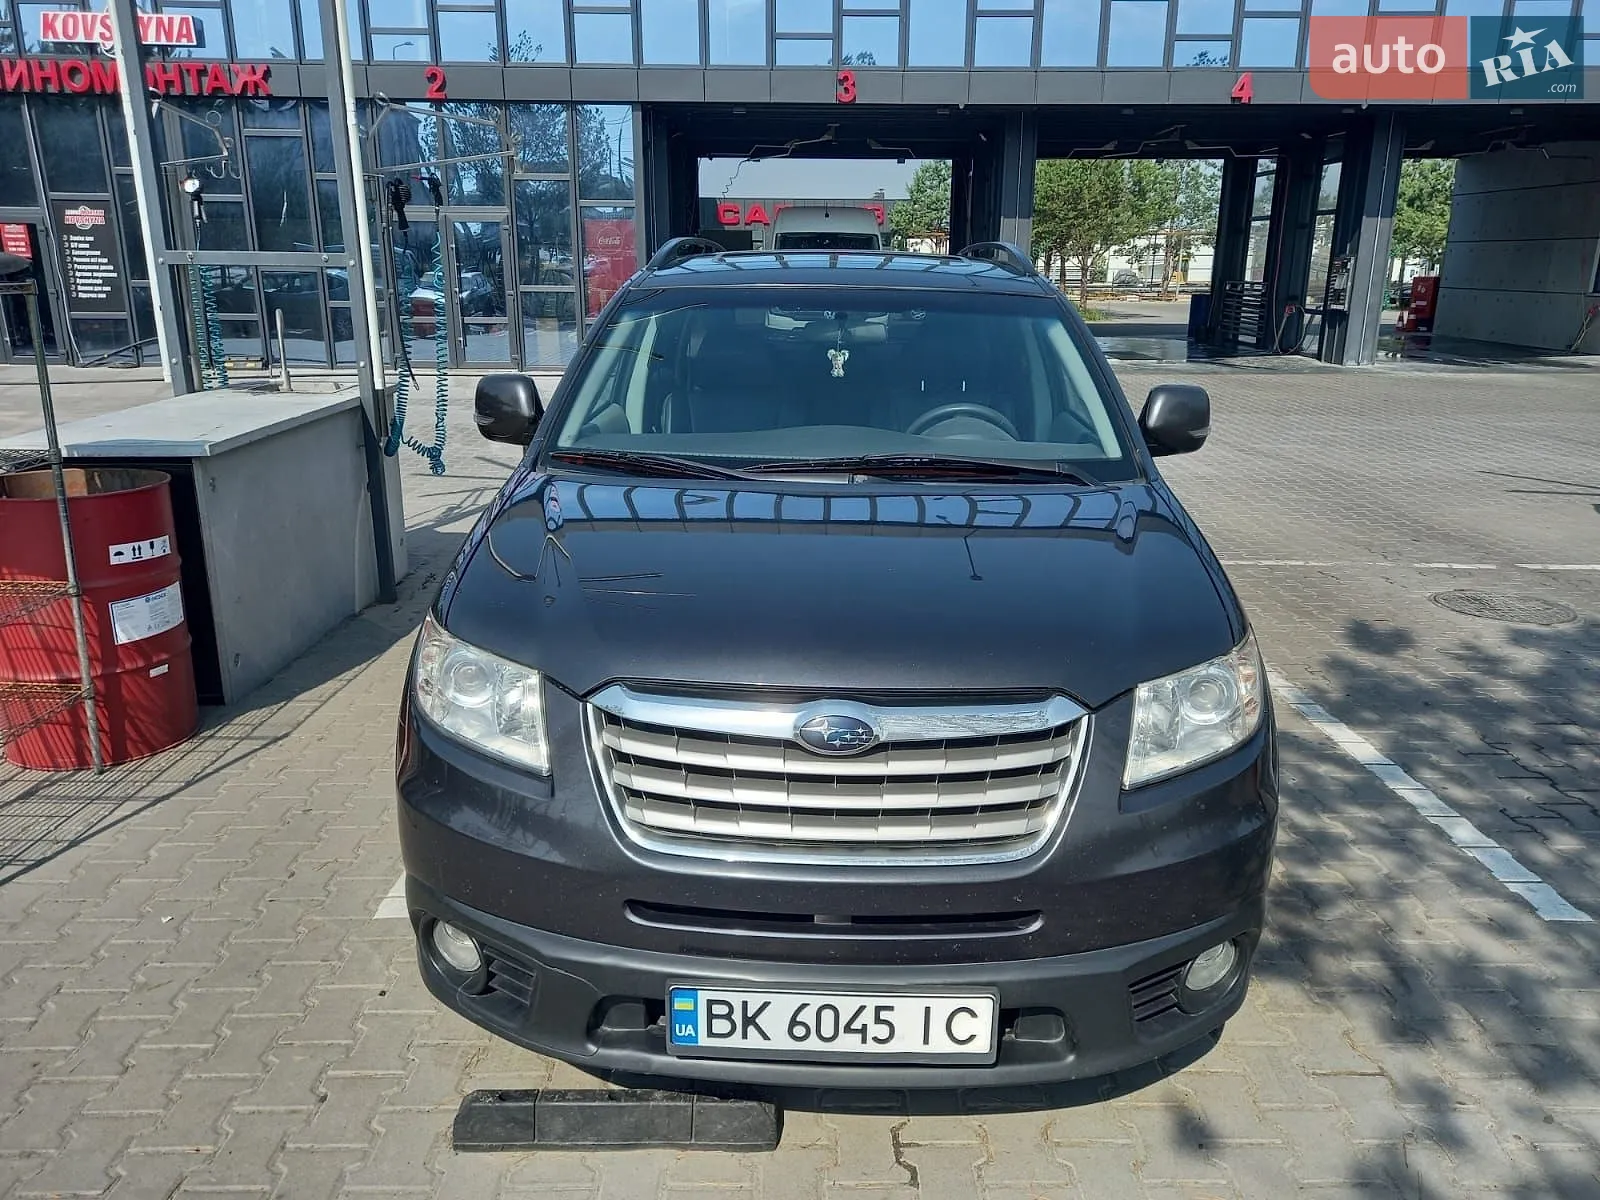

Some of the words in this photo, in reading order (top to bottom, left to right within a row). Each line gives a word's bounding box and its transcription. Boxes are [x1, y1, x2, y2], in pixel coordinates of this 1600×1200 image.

[42, 13, 196, 43] KOVSYNA
[0, 59, 271, 95] ИНОМНТАЖ
[424, 66, 446, 100] 2
[837, 70, 856, 103] 3
[1231, 71, 1253, 104] 4
[675, 1023, 696, 1037] UA
[706, 999, 771, 1040] BK
[787, 1003, 896, 1045] 6045
[923, 1006, 979, 1046] IC
